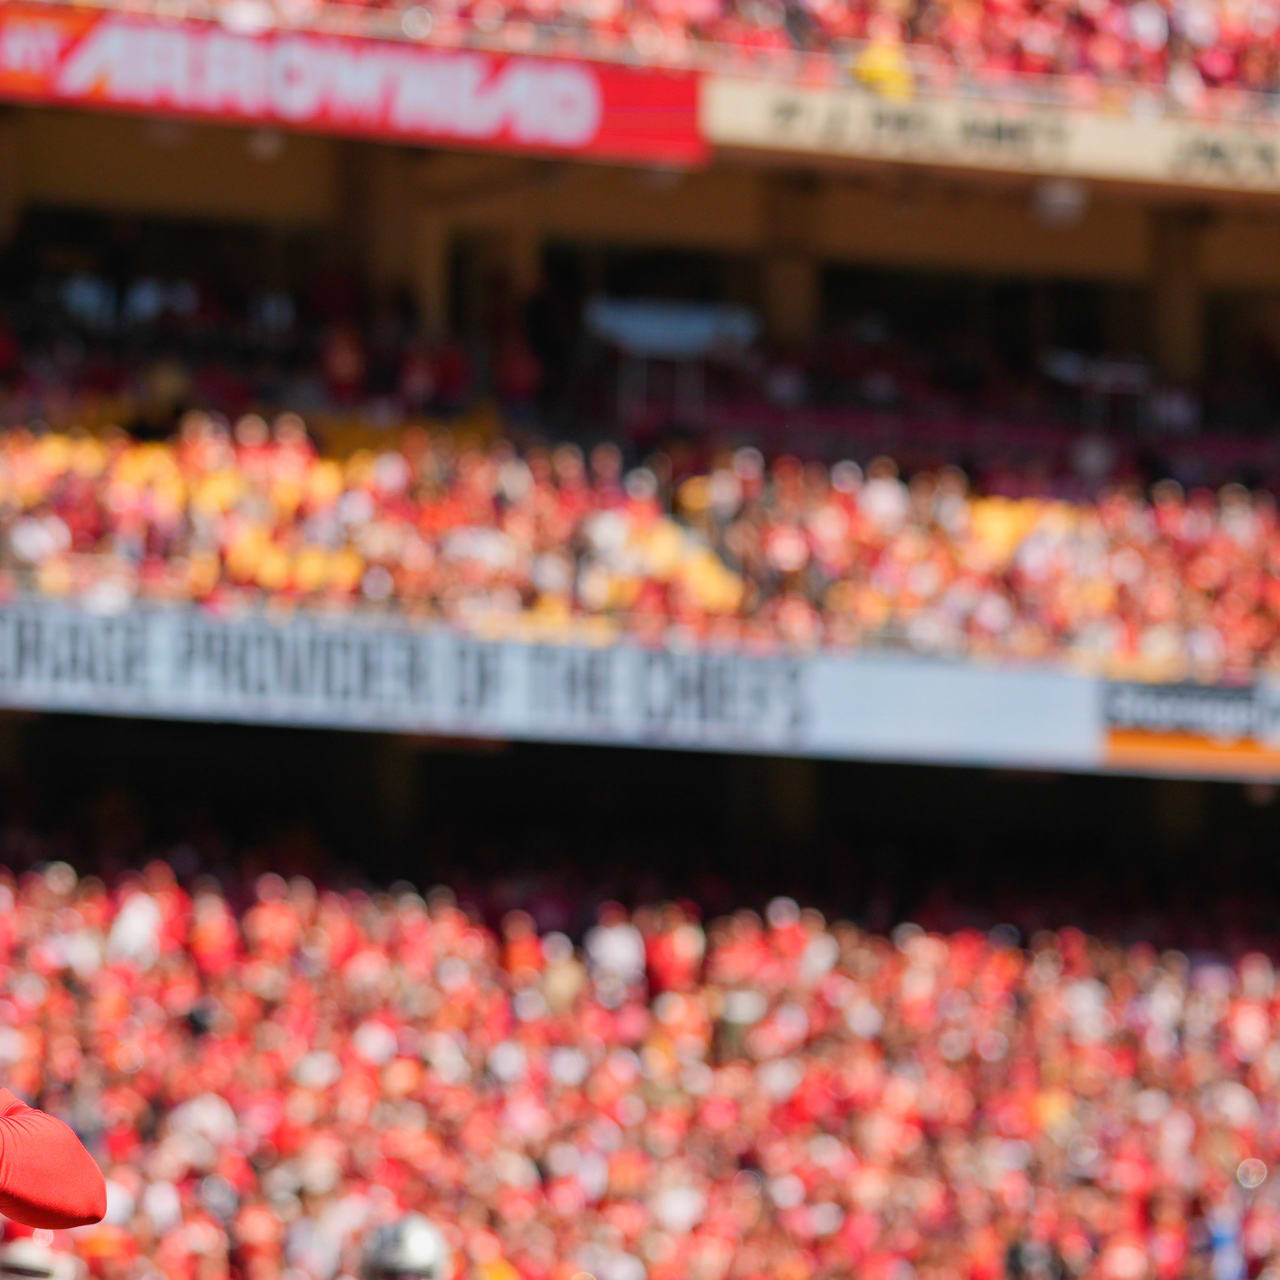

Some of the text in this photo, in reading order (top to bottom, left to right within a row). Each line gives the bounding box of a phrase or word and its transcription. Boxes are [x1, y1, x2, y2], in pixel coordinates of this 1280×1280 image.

[55, 22, 604, 147] ARROWHEAD
[177, 614, 425, 704] PROVIDER
[454, 640, 500, 707] OF
[530, 646, 616, 714] THE
[638, 652, 806, 730] CHIEFS
